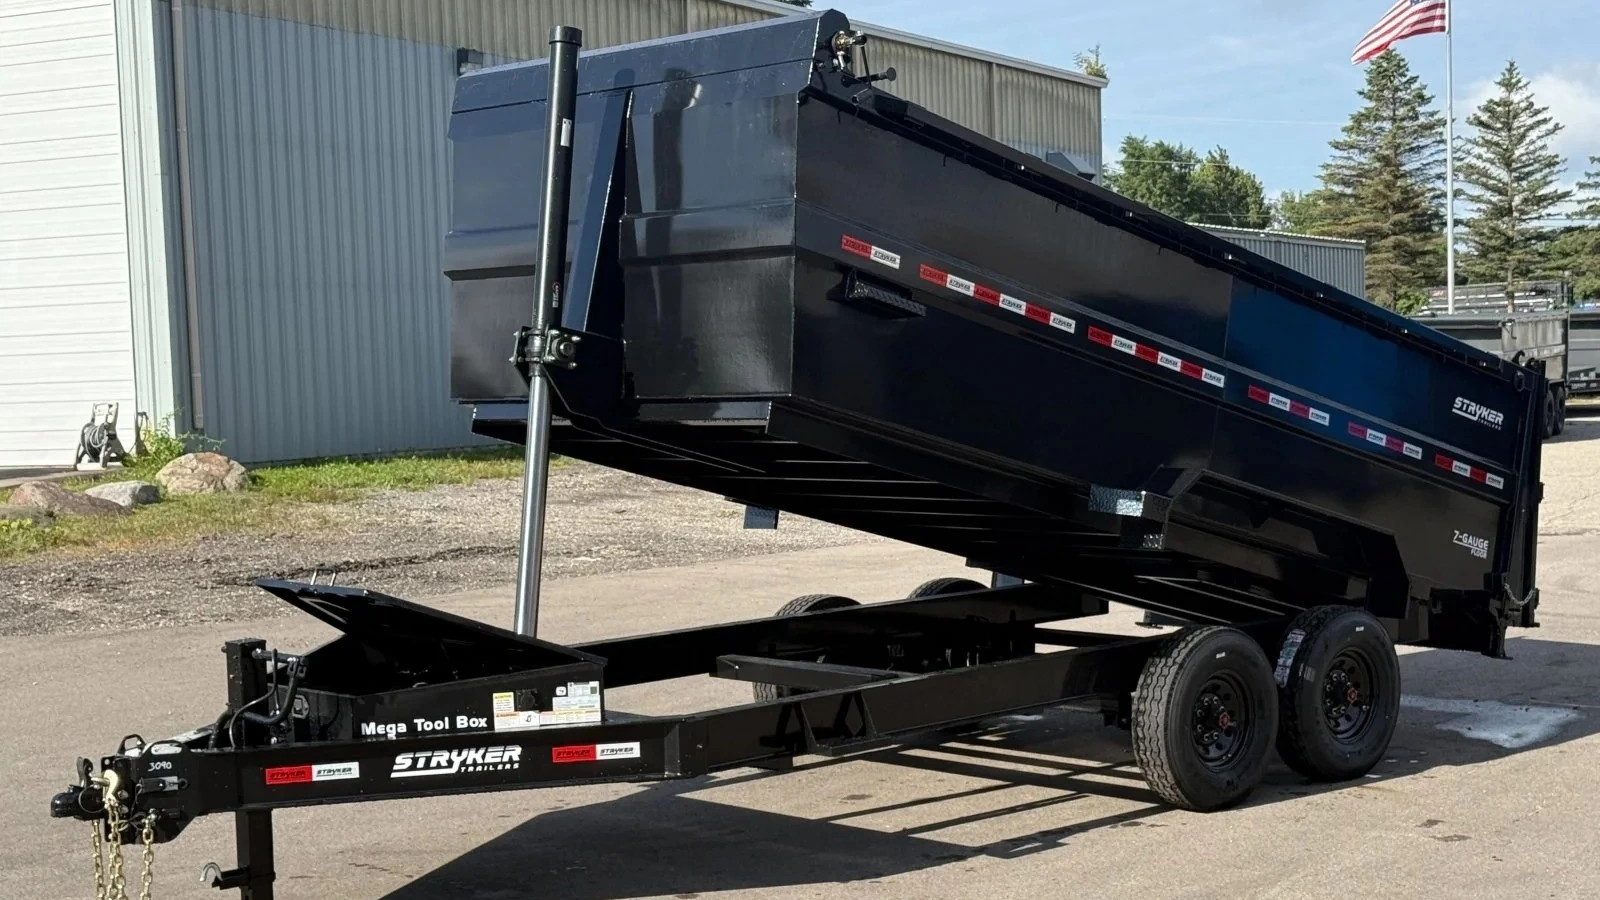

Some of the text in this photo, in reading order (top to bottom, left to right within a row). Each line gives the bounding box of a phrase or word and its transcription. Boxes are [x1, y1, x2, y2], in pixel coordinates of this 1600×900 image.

[1452, 396, 1504, 425] STRYKER
[1453, 530, 1489, 550] 7-GAUGE
[361, 721, 407, 739] Mega
[413, 716, 450, 731] Tool
[456, 715, 488, 729] Box
[390, 744, 522, 778] STRYKER
[600, 747, 634, 756] STRYKER
[315, 767, 353, 778] STRYKER
[460, 763, 520, 773] TRAILERS
